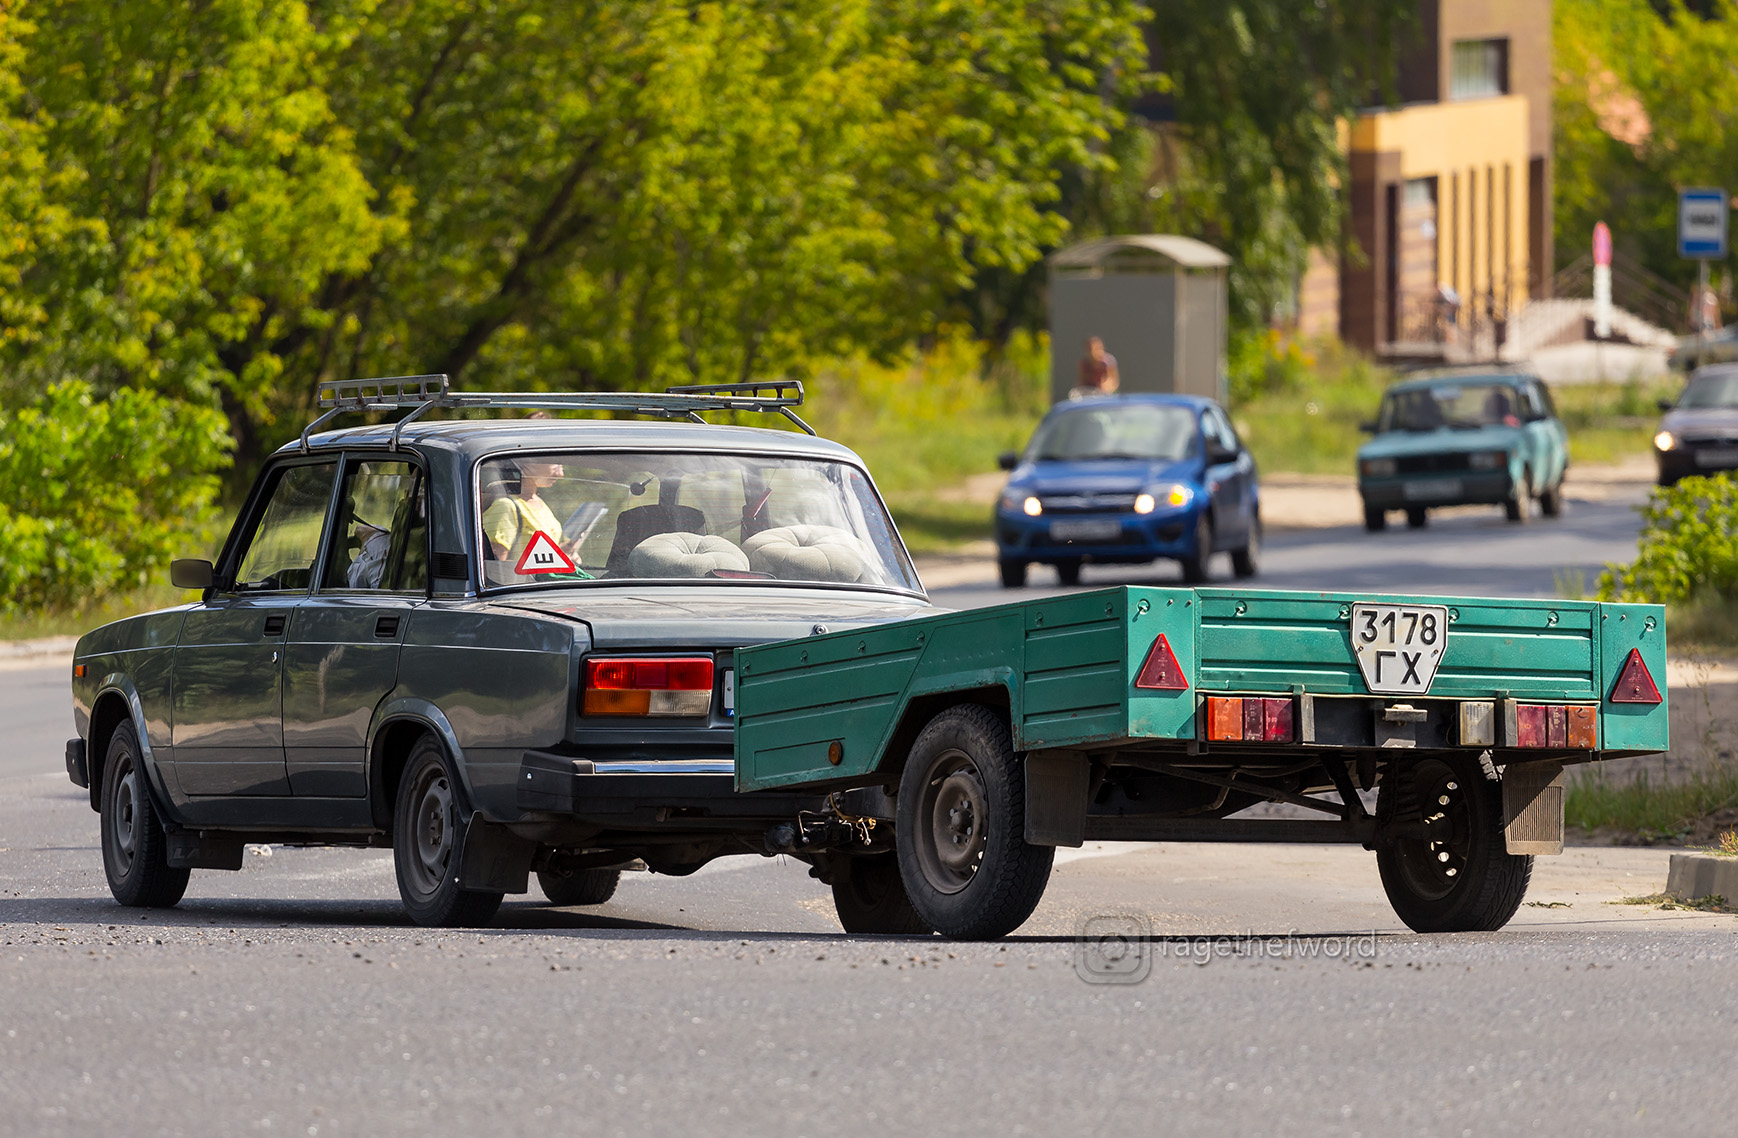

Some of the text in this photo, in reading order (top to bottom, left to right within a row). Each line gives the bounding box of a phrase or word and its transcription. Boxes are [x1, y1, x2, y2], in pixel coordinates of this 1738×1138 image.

[534, 553, 554, 564] Ш
[1361, 610, 1437, 645] 3178
[1375, 650, 1422, 685] ГХ
